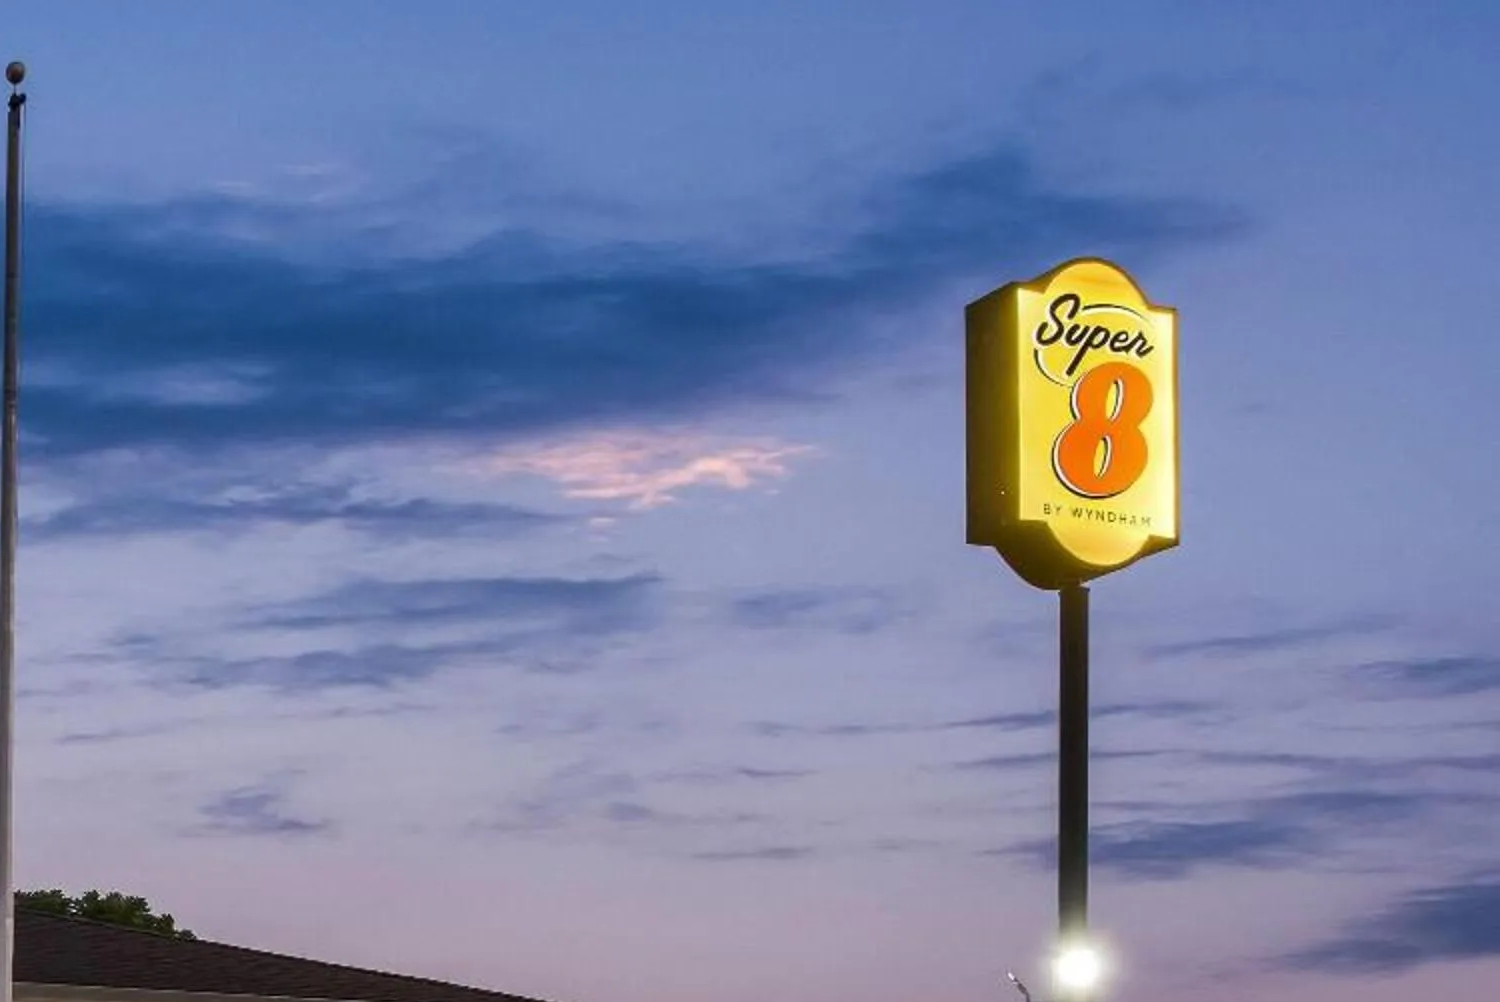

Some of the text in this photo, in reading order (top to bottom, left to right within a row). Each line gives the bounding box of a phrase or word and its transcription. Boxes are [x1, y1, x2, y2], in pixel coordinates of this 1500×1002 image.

[1036, 293, 1154, 376] Super
[1052, 361, 1154, 499] 8
[1043, 503, 1152, 527] BY WYNDHAM
